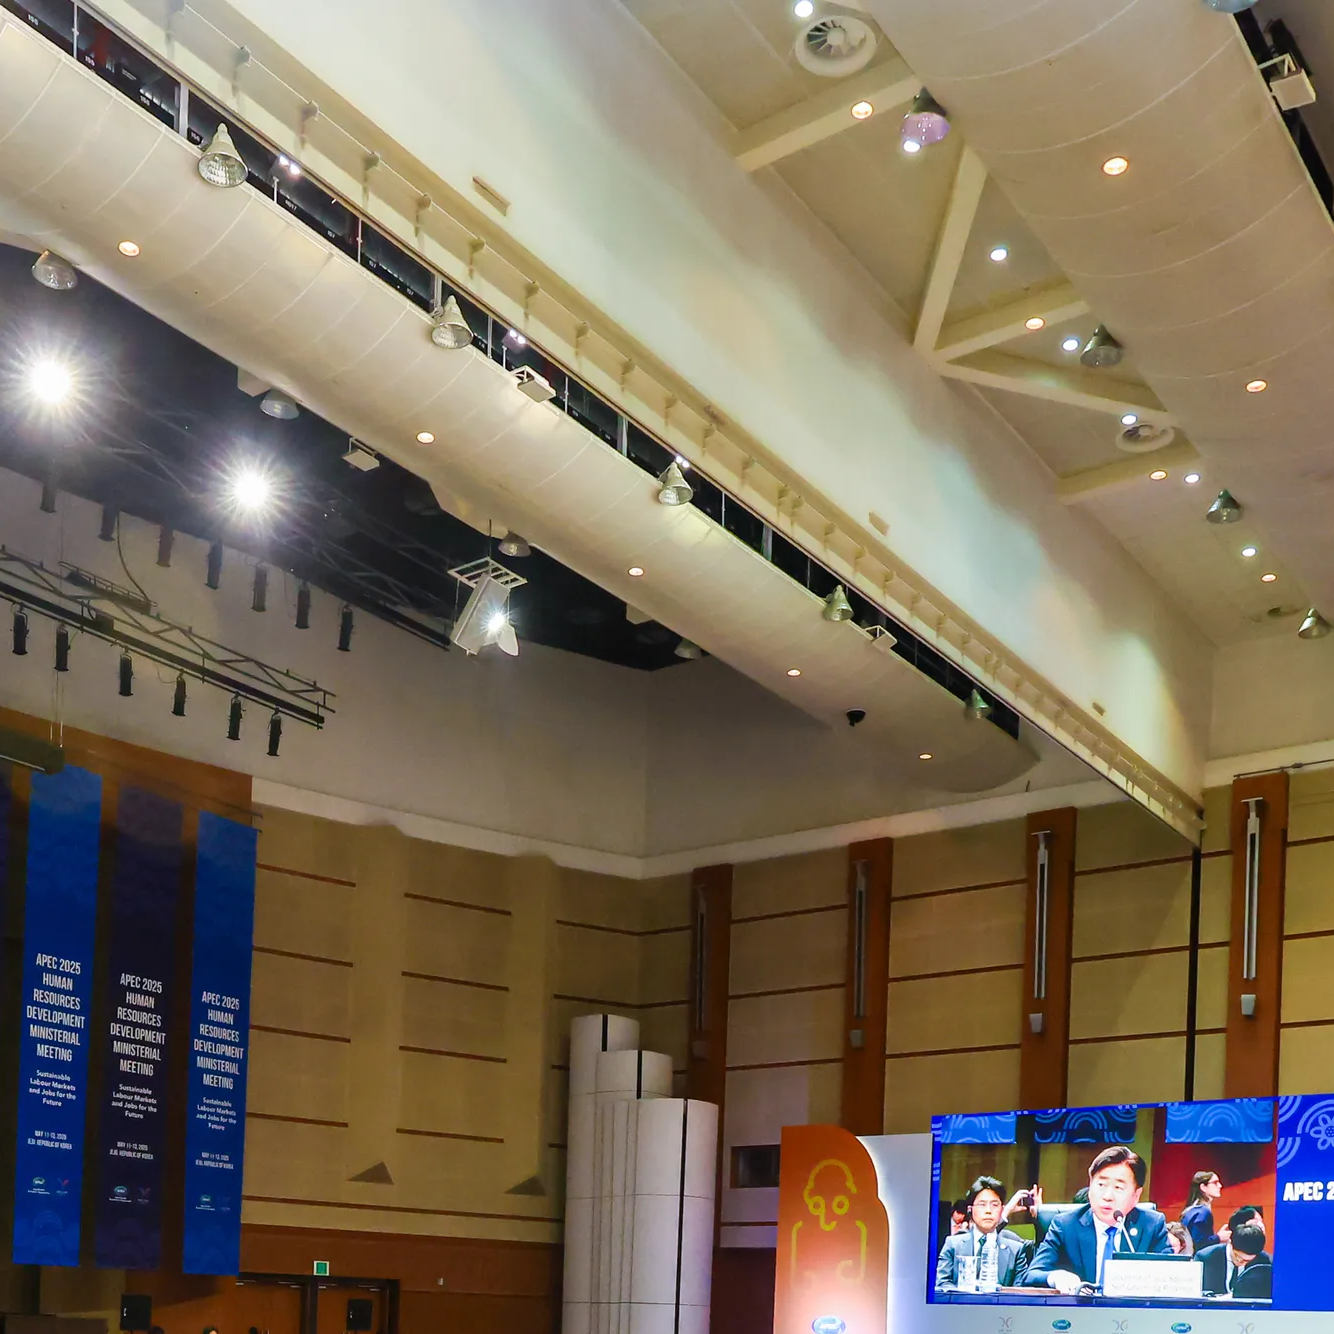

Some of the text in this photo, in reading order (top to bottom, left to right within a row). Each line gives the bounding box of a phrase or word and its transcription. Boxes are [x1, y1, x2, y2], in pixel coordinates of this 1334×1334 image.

[36, 953, 81, 975] APEC 2025
[43, 972, 73, 991] HUMAN
[120, 973, 162, 994] APEC 2025
[33, 988, 81, 1010] RESOURCES
[126, 991, 155, 1009] HUMAN
[201, 991, 240, 1009] APEC 2025
[26, 1005, 85, 1029] DEVELOPMENT
[117, 1006, 162, 1027] RESOURCES
[208, 1009, 234, 1026] HUMAN
[30, 1024, 81, 1046] MINISTERIAL
[110, 1022, 166, 1045] DEVELOPMENT
[199, 1023, 240, 1042] RESOURCES
[36, 1043, 72, 1062] MEETING
[113, 1040, 161, 1061] MINISTERIAL
[194, 1038, 244, 1059] DEVELOPMENT
[120, 1059, 154, 1076] MEETING
[197, 1056, 240, 1075] MINISTERIAL
[203, 1073, 233, 1090] MEETING
[1283, 1181, 1323, 1202] APEC
